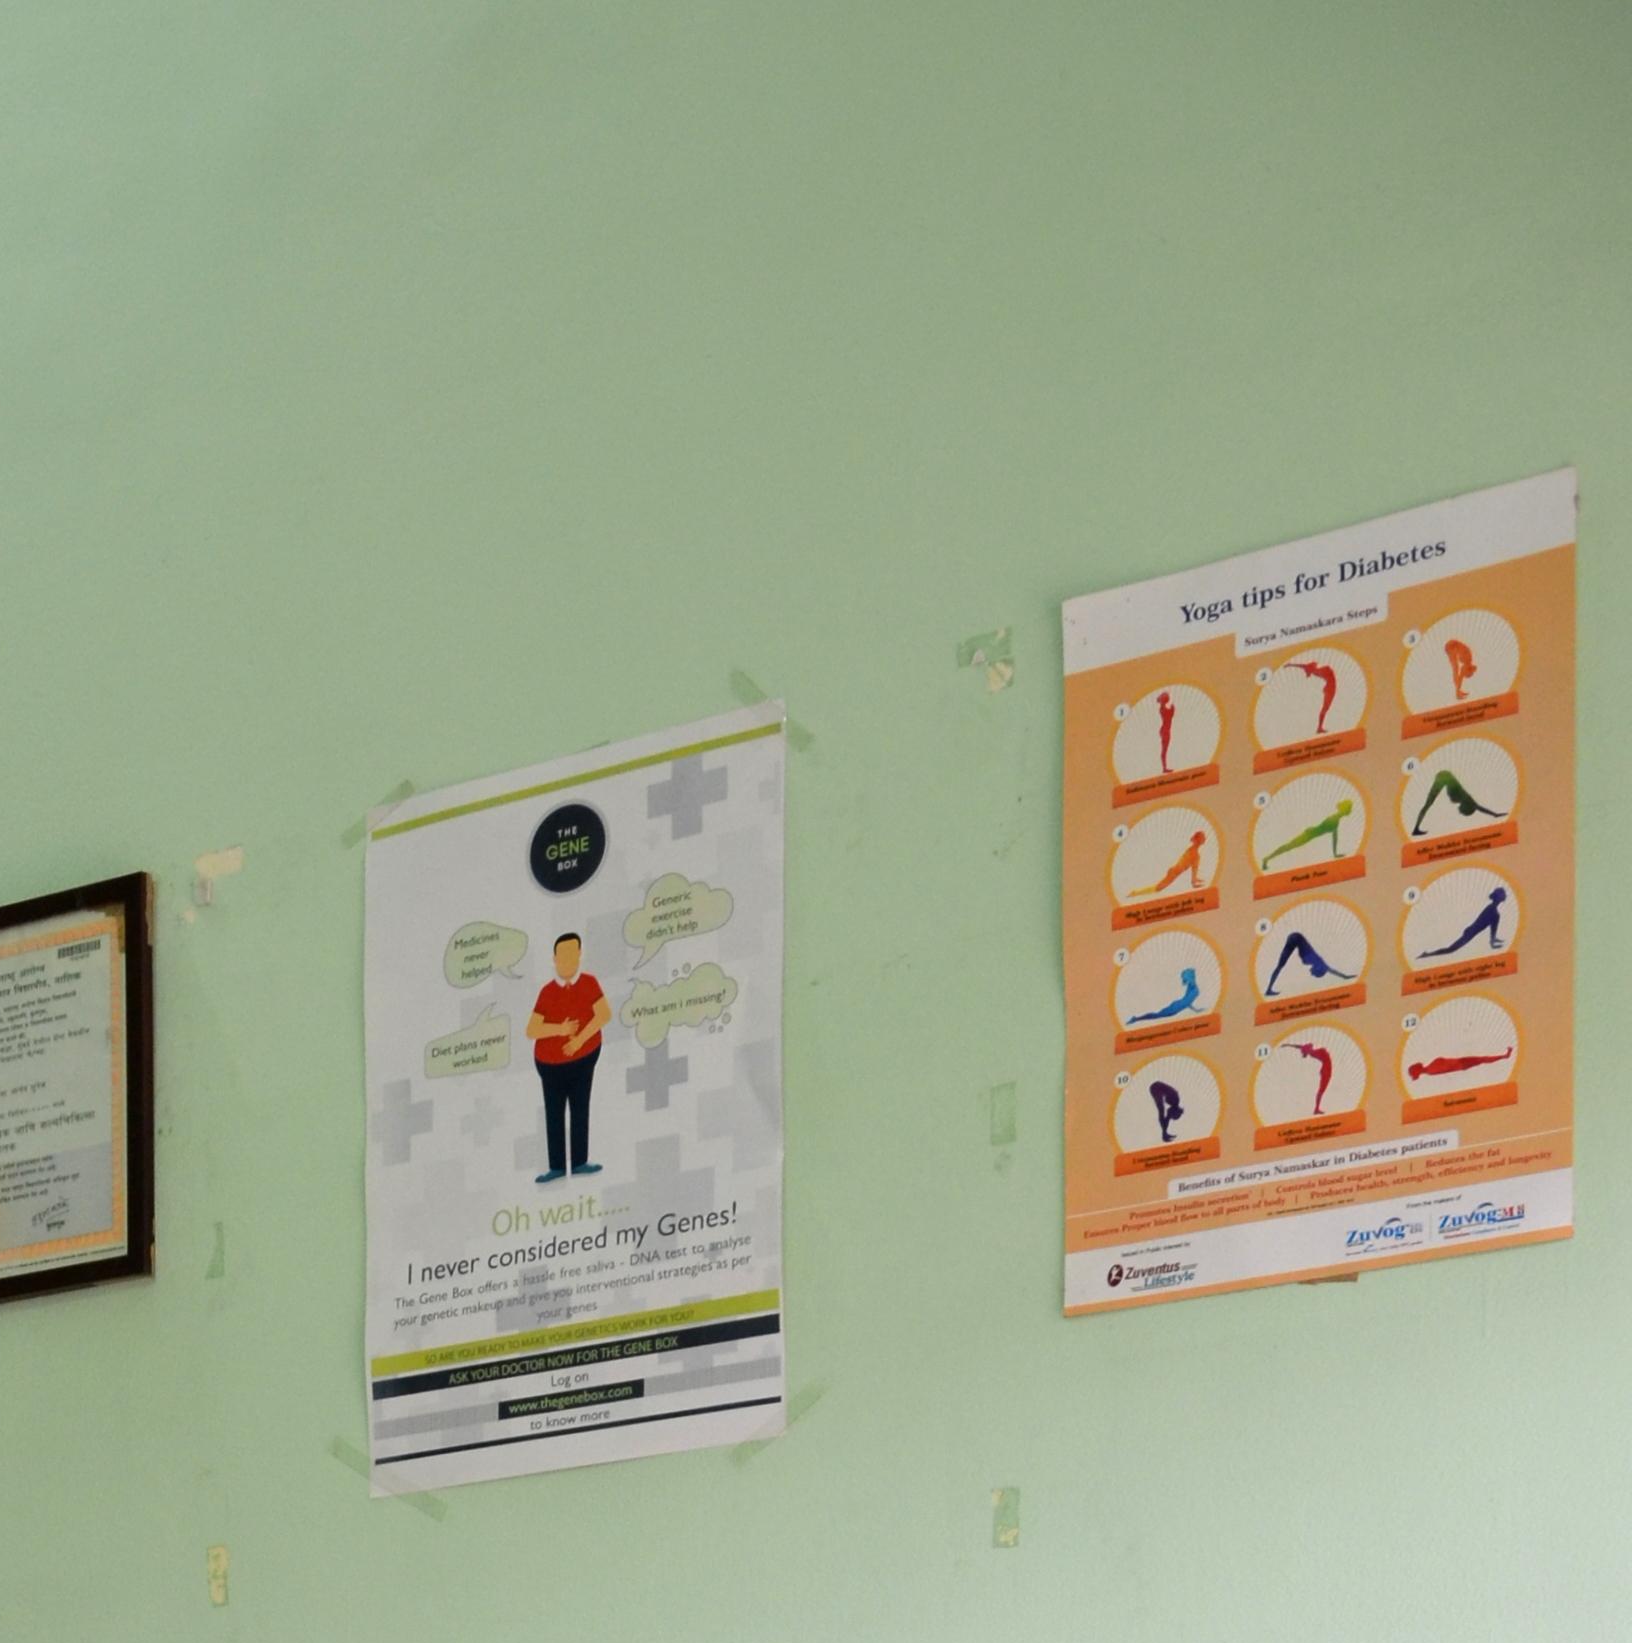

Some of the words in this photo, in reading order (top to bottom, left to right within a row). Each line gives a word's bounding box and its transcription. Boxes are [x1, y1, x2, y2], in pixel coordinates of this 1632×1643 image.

[1180, 600, 1232, 625] Yoga
[1242, 584, 1286, 610] tips
[1293, 572, 1331, 595] for
[1338, 540, 1447, 583] Diabetes
[1245, 632, 1277, 647] Surya
[1280, 614, 1343, 637] Namaskara
[1347, 606, 1378, 620] Steps
[557, 825, 578, 838] THE
[545, 836, 590, 861] GENE
[557, 858, 578, 872] BOX
[652, 891, 692, 908] Generic
[651, 906, 693, 924] exercise
[646, 924, 673, 940] didn't
[677, 920, 698, 932] help
[454, 932, 500, 950] Medicines
[464, 949, 490, 963] never
[461, 963, 493, 980] helped
[631, 1005, 658, 1018] What
[661, 1001, 677, 1012] am
[431, 1046, 452, 1058] Diet
[454, 1042, 478, 1056] plans
[480, 1034, 506, 1047] never
[453, 1052, 489, 1068] worked
[1178, 1177, 1221, 1193] Benefits
[1224, 1173, 1236, 1184] of
[1238, 1168, 1270, 1182] Surya
[1273, 1156, 1331, 1175] Namaskar
[1334, 1154, 1346, 1165] in
[1349, 1146, 1398, 1164] Diabetes
[1401, 1137, 1448, 1155] patients
[492, 1205, 530, 1236] Oh
[421, 1256, 480, 1283] never
[488, 1225, 607, 1269] considered
[616, 1223, 648, 1249] my
[657, 1200, 737, 1236] Genes!
[394, 1296, 415, 1310] The
[419, 1291, 448, 1305] Gene
[452, 1286, 473, 1299] Box
[478, 1278, 509, 1294] offers
[523, 1270, 555, 1286] hassle
[560, 1265, 582, 1278] free
[586, 1259, 615, 1274] saliva
[630, 1250, 661, 1267] DNA
[665, 1247, 687, 1260] test
[691, 1244, 705, 1256] to
[709, 1234, 752, 1253] analyse
[1124, 1261, 1181, 1280] Zuventus
[1144, 1269, 1195, 1288] Lifestyle
[393, 1314, 418, 1331] your
[420, 1307, 459, 1326] genetic
[462, 1299, 503, 1318] makeup
[507, 1293, 526, 1307] and
[528, 1290, 551, 1306] give
[553, 1287, 573, 1302] you
[576, 1269, 655, 1295] interventional
[658, 1259, 713, 1279] strategies
[716, 1257, 728, 1269] as
[731, 1255, 752, 1271] per
[537, 1305, 562, 1322] your
[565, 1300, 598, 1320] genes
[449, 1371, 469, 1386] ASK
[470, 1365, 499, 1381] YOUR
[501, 1359, 546, 1377] DOCTOR
[548, 1355, 575, 1370] NOW
[576, 1351, 598, 1365] FOR
[600, 1347, 621, 1361] THE
[622, 1342, 654, 1358] GENE
[655, 1337, 678, 1352] BOX
[550, 1373, 571, 1388] Log
[574, 1372, 589, 1383] on
[508, 1385, 633, 1414] www.thegenebox.com
[530, 1419, 542, 1430] to
[546, 1415, 576, 1428] know
[580, 1410, 610, 1422] more
